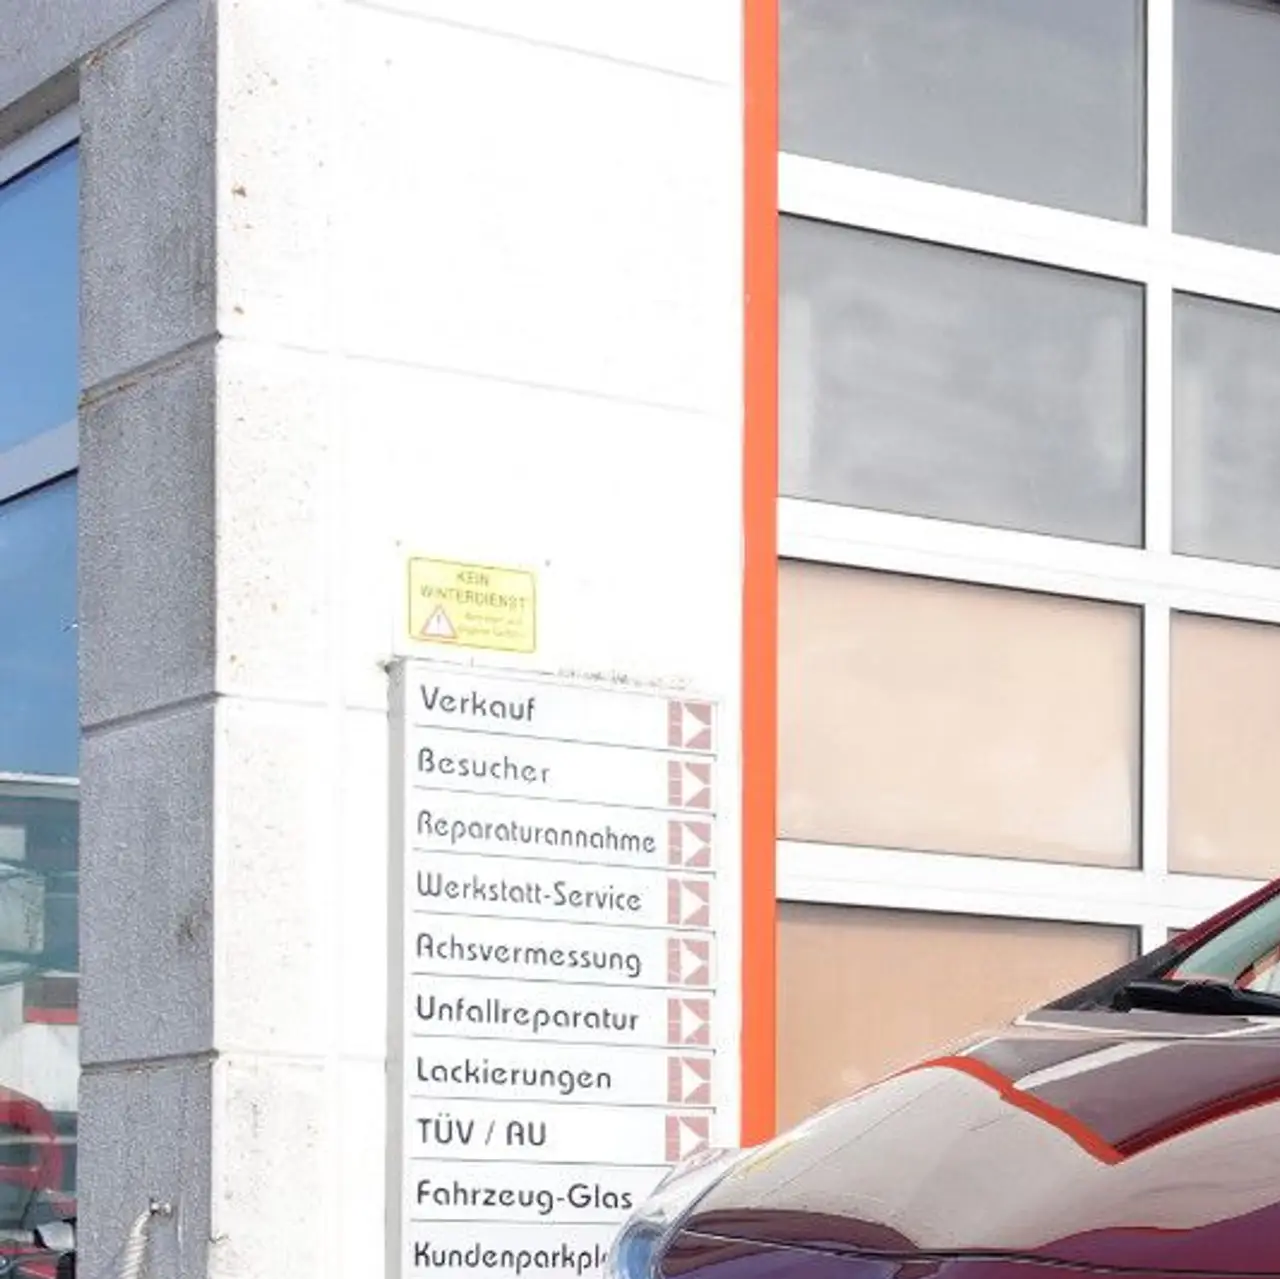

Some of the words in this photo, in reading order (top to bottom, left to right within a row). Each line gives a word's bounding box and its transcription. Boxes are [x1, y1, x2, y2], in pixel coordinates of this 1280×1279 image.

[420, 684, 536, 722] Verkauf
[418, 747, 550, 784] Besucher
[417, 810, 657, 853] Reparaturannahme
[416, 871, 642, 911] Werkstatt-Service
[415, 932, 642, 978] Achsvermessung
[416, 994, 639, 1033] Unfallreparatur
[416, 1056, 612, 1095] Lackierungen
[416, 1113, 475, 1146] TÜV
[505, 1119, 547, 1147] AU
[416, 1179, 634, 1215] Fahrzeug-Glas
[413, 1241, 608, 1277] Kundenparkpl
